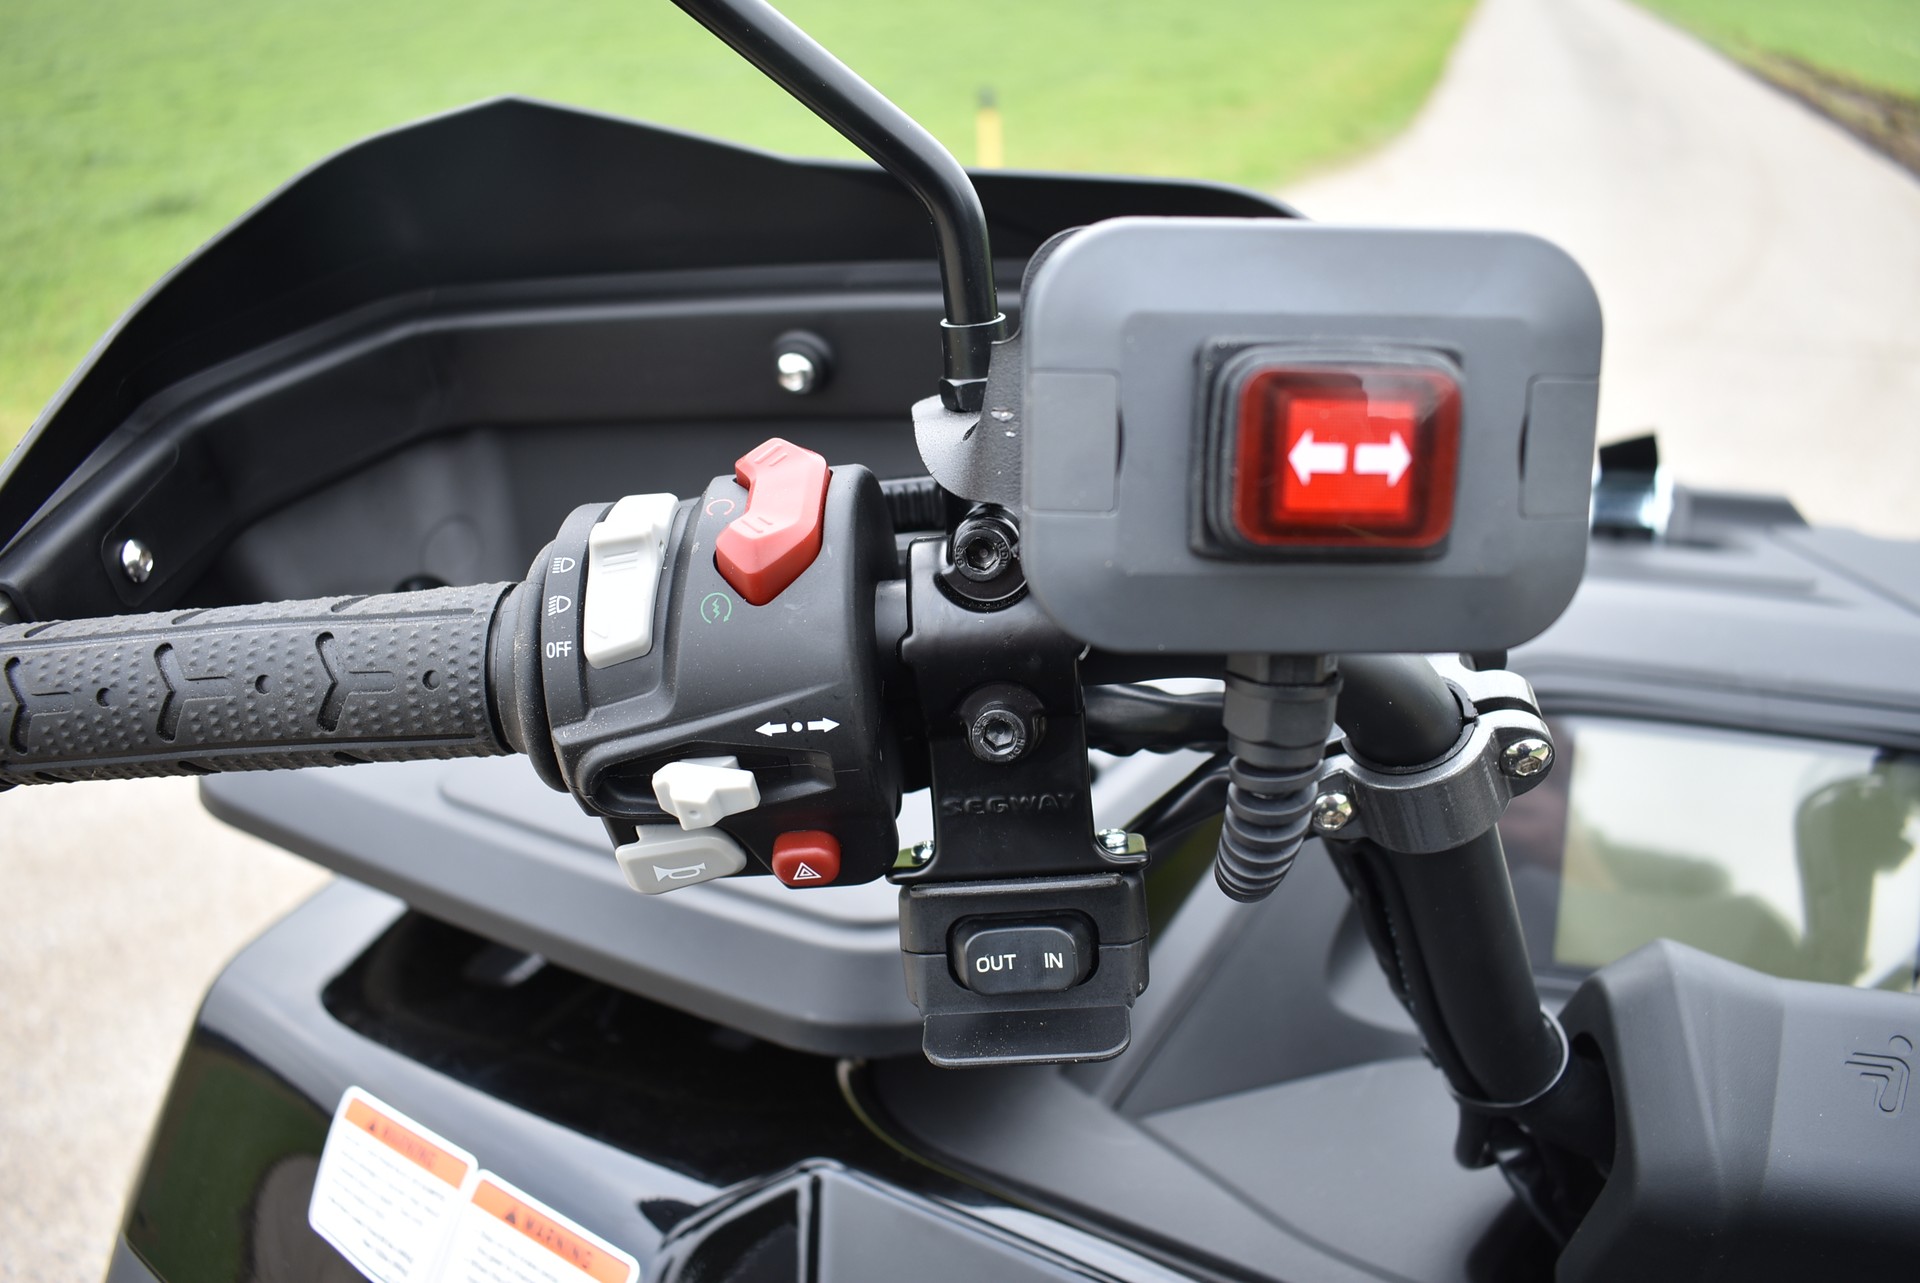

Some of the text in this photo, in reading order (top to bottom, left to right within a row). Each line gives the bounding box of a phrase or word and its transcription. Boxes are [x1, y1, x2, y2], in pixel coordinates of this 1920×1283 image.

[545, 640, 572, 659] OFF
[942, 793, 1075, 816] SEGWAY
[976, 952, 1064, 973] OUT IN
